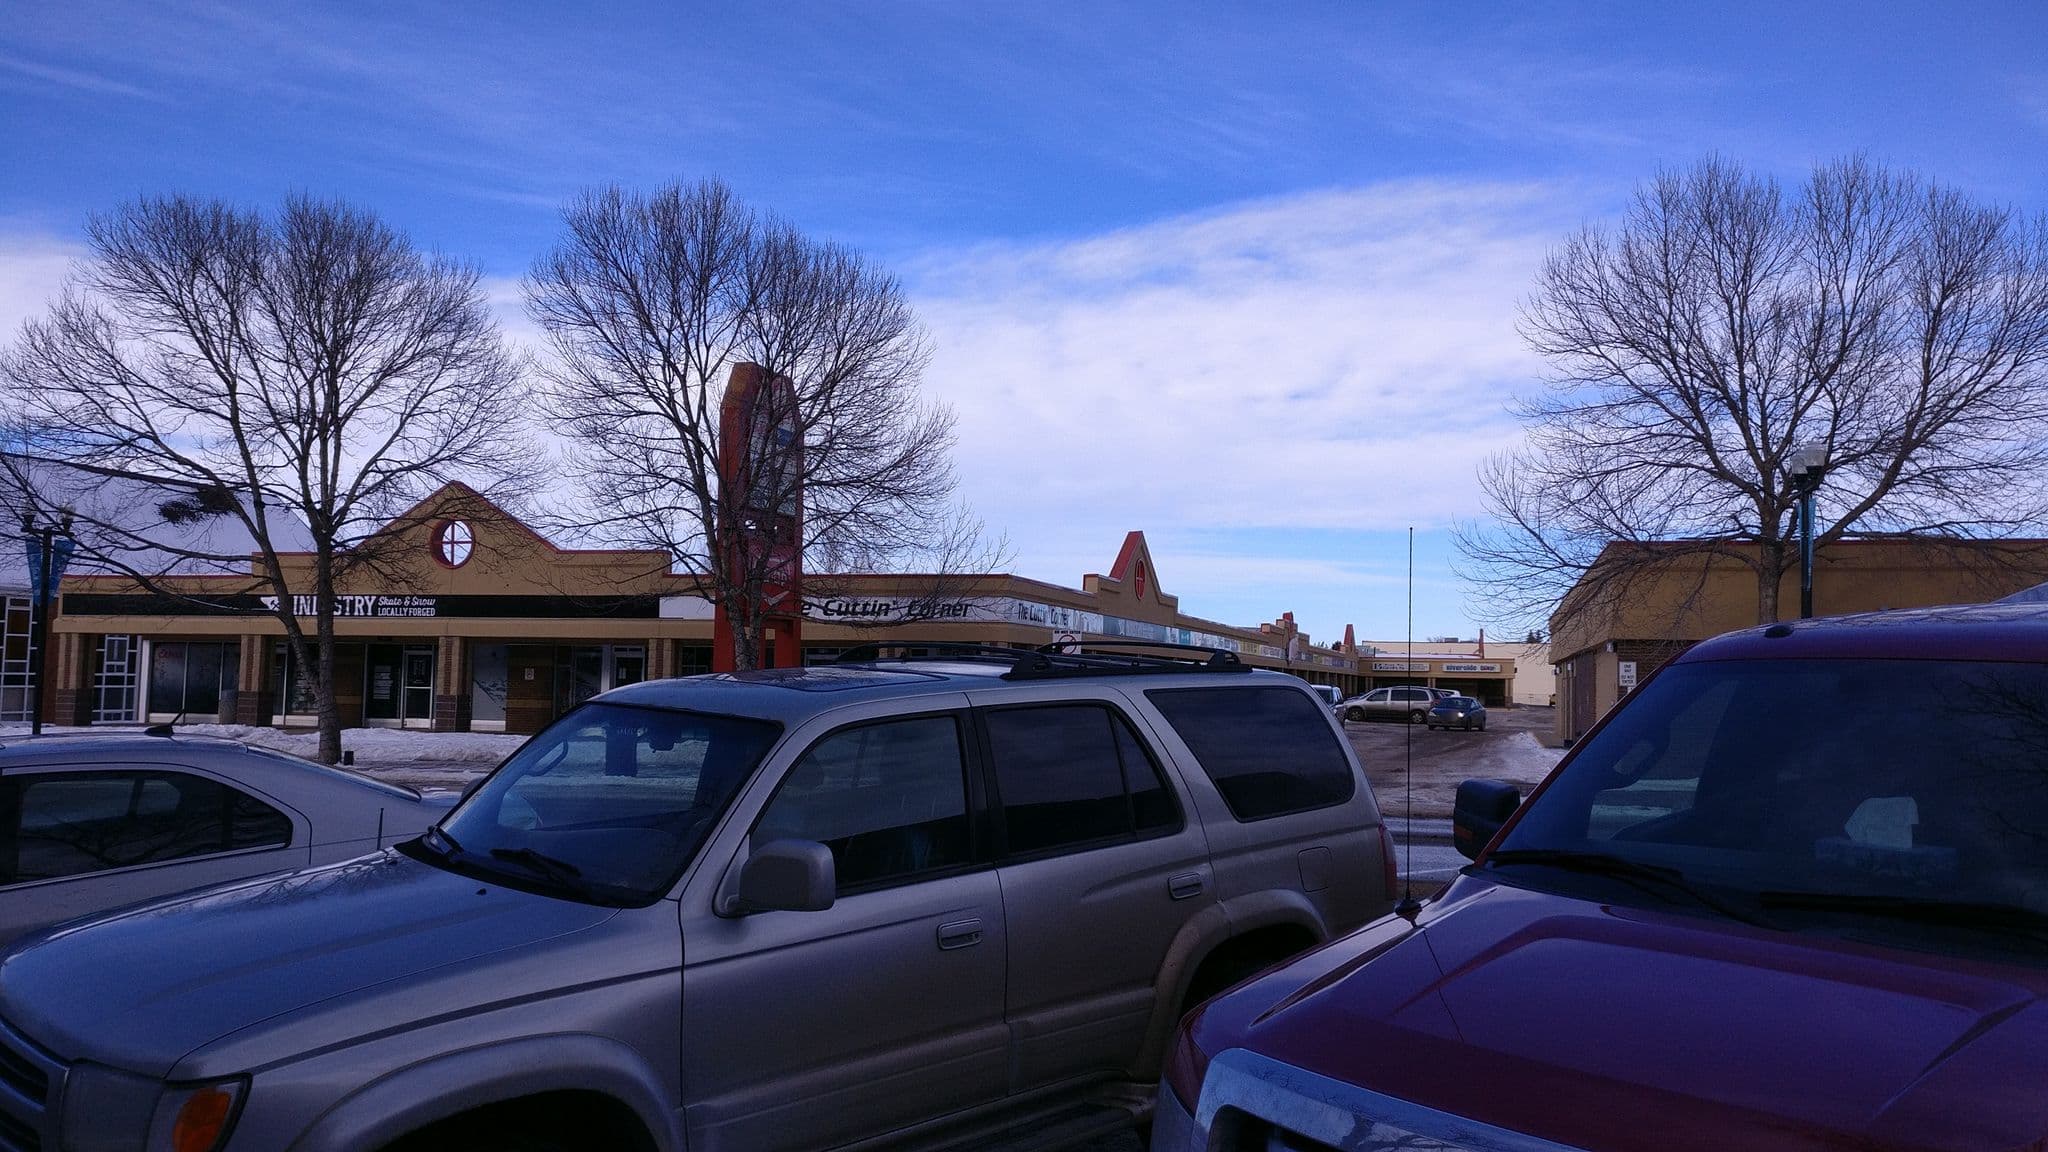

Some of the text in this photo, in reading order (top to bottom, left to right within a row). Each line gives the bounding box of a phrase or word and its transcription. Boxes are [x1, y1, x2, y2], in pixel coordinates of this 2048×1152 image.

[293, 595, 377, 616] INSTRY
[377, 596, 436, 607] Skate & Snow
[822, 599, 897, 617] Cuttin'
[906, 600, 970, 618] Corner
[377, 607, 436, 617] LOCALLY FORGED
[1018, 603, 1028, 620] The
